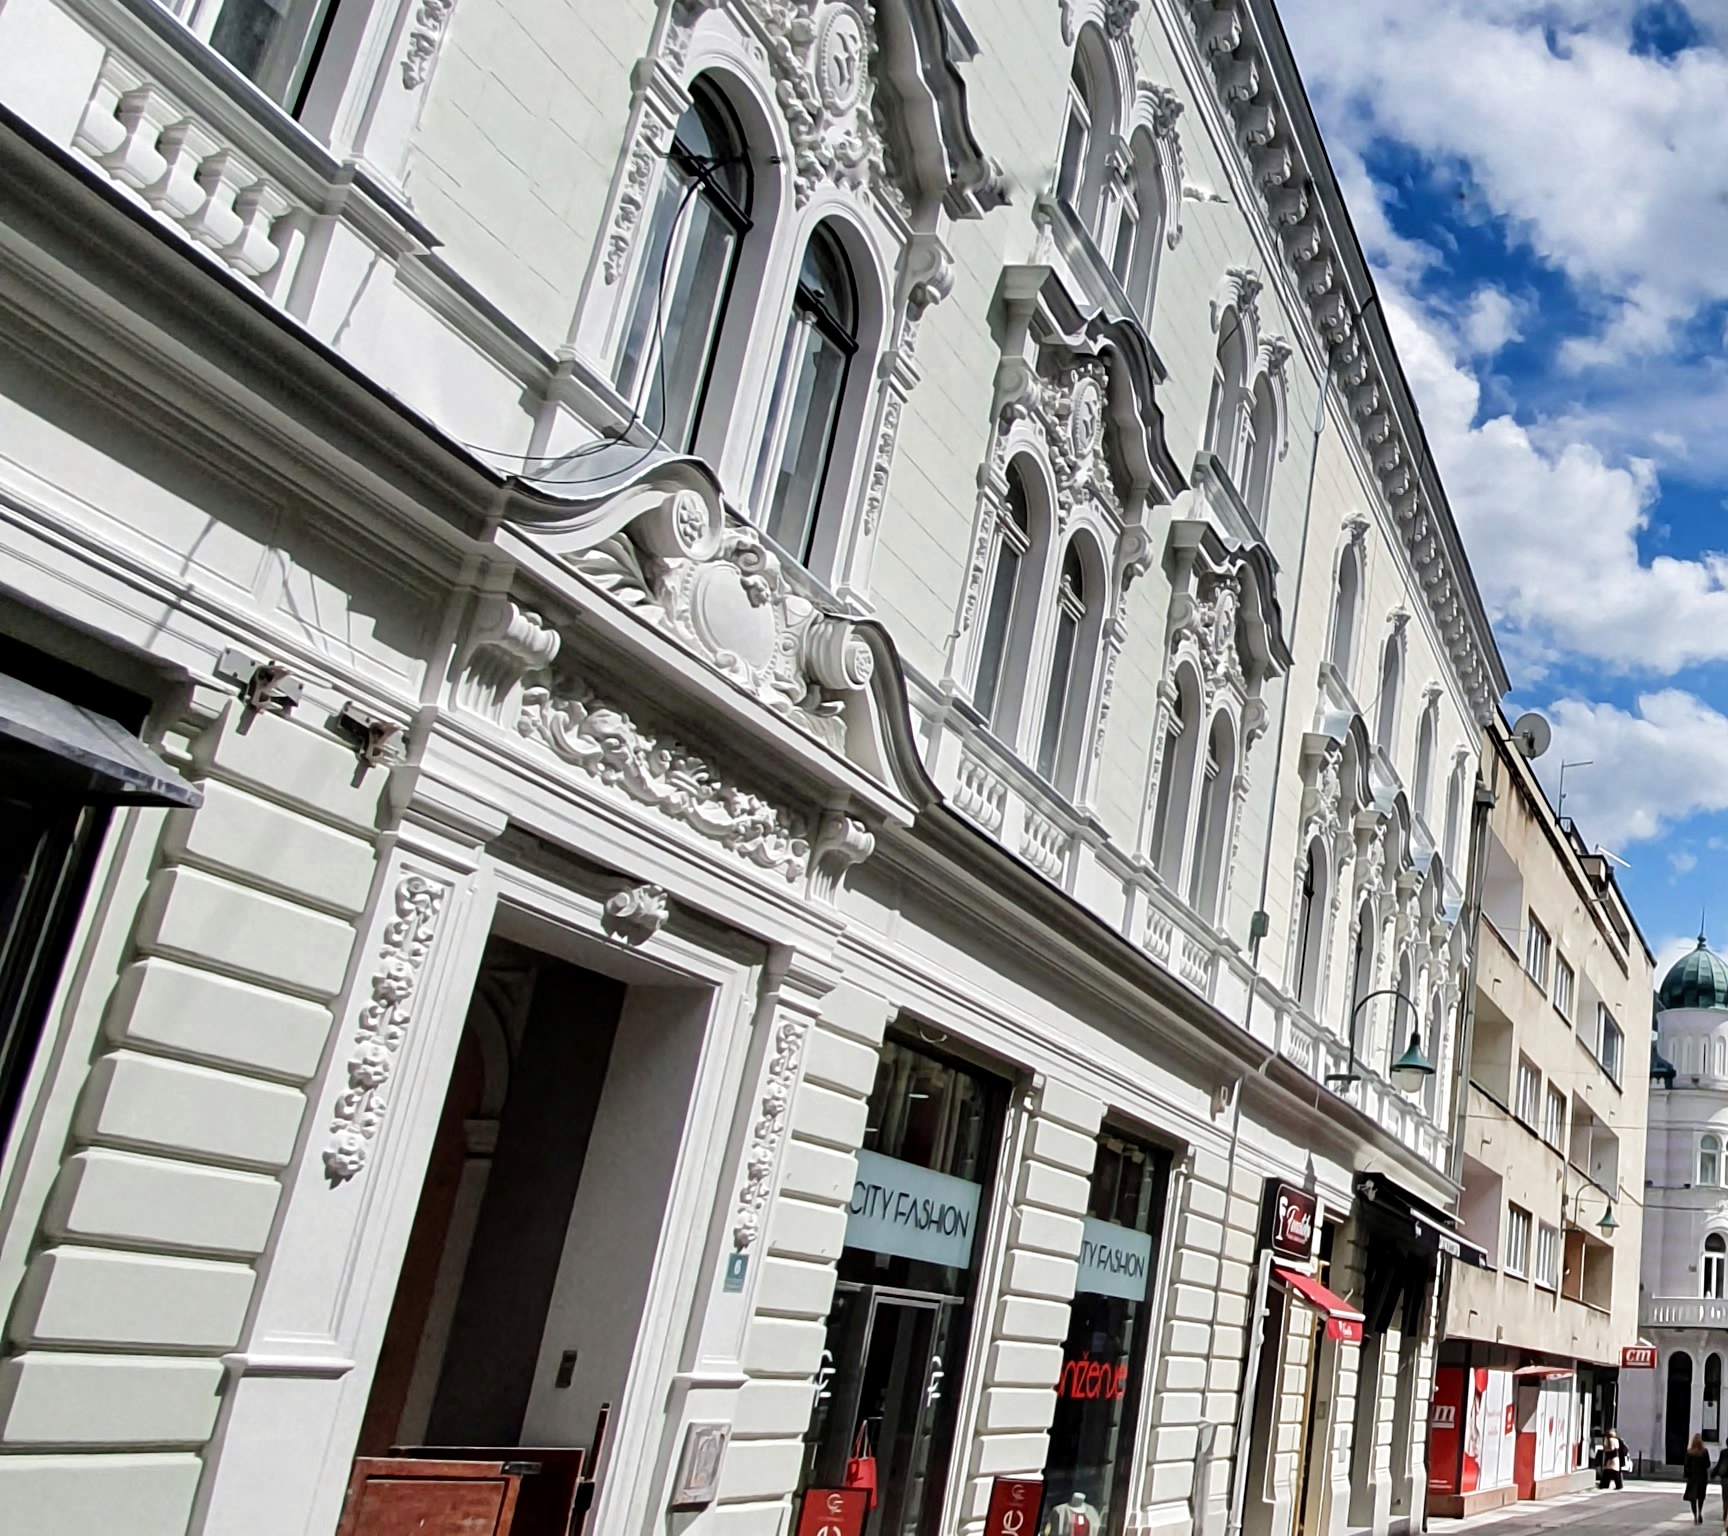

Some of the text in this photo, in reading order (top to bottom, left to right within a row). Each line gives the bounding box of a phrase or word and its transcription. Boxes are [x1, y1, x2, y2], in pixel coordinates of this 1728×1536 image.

[850, 1180, 971, 1239] CITY FASHION
[1097, 1244, 1145, 1278] FASHION
[1057, 1350, 1127, 1401] niženje
[1626, 1349, 1651, 1362] cm
